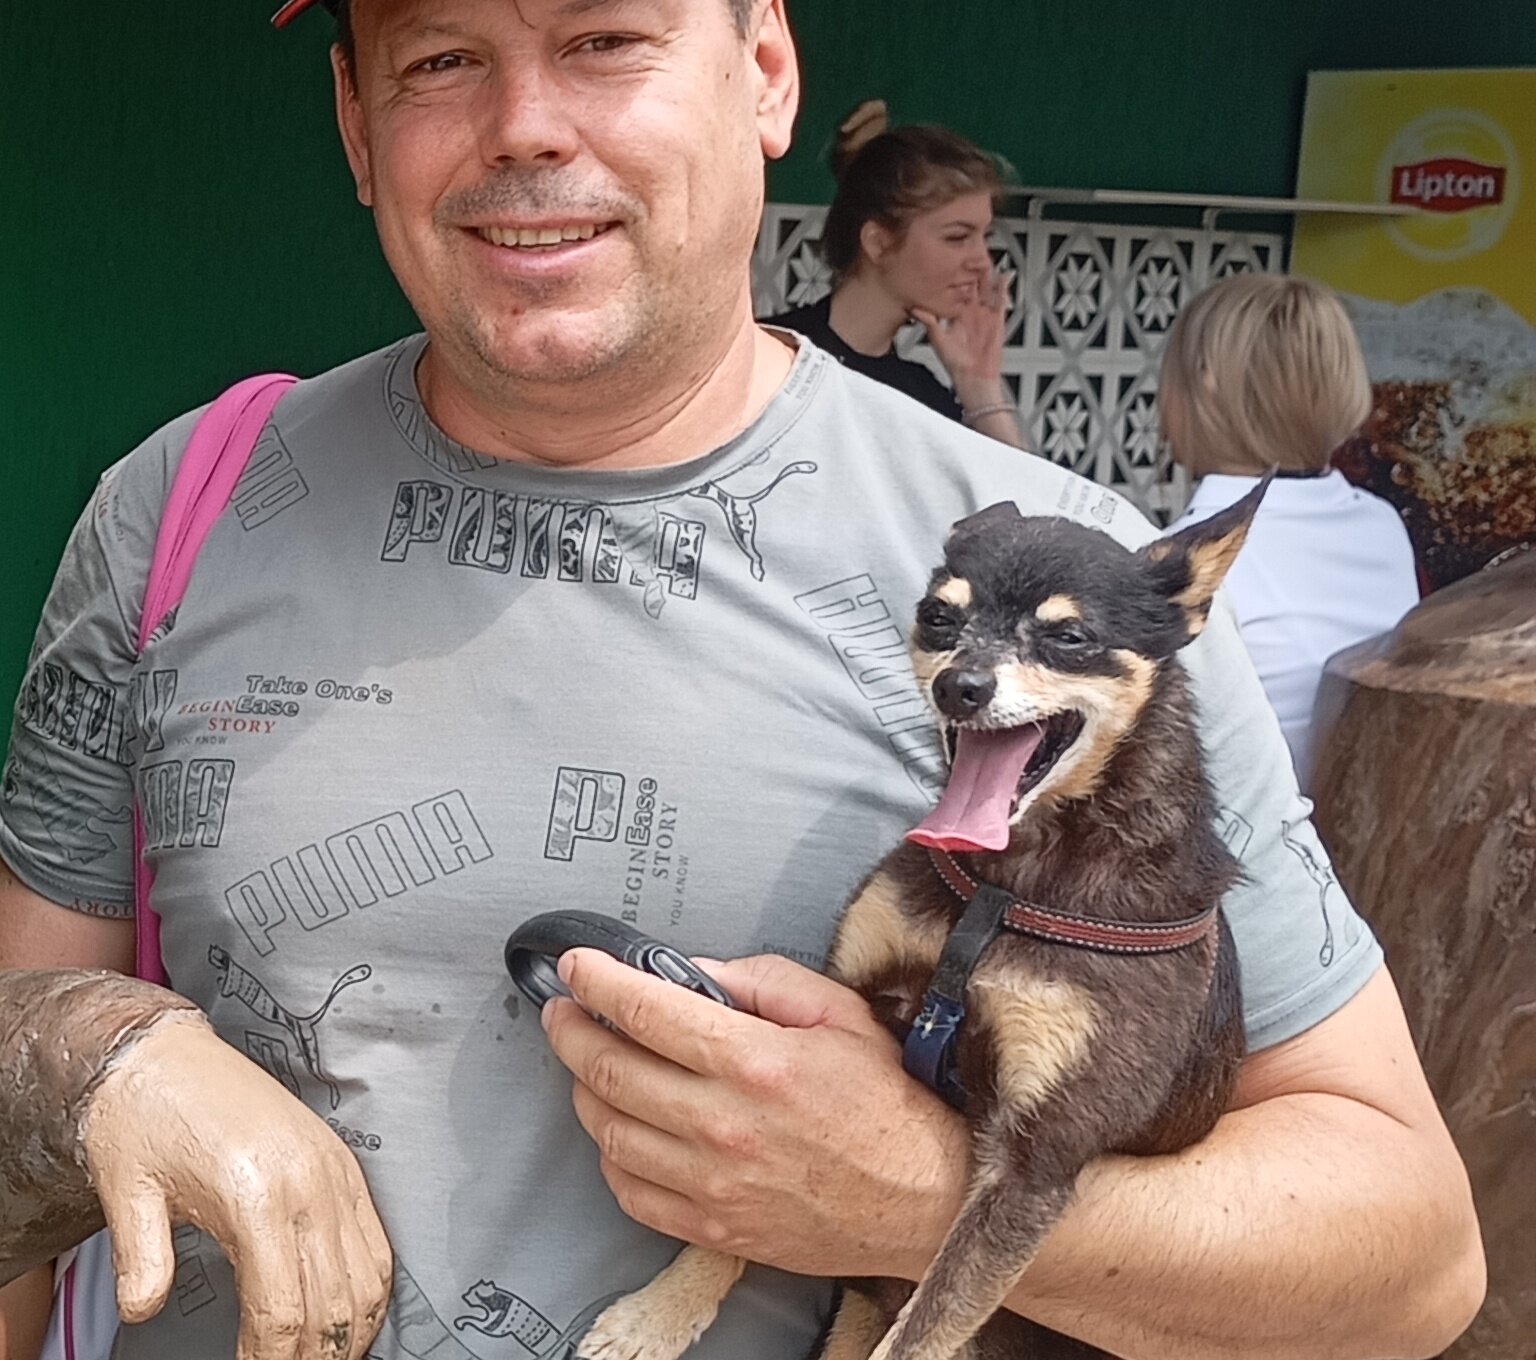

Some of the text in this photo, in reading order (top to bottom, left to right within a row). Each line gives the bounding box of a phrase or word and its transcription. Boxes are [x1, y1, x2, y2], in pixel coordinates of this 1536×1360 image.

[1399, 169, 1496, 201] Lipton
[235, 694, 300, 718] Ease
[246, 674, 393, 706] Take One's
[207, 717, 277, 734] STORY
[621, 777, 658, 924] BEGIN Ease
[652, 801, 678, 880] STORY
[224, 789, 494, 957] PUMA
